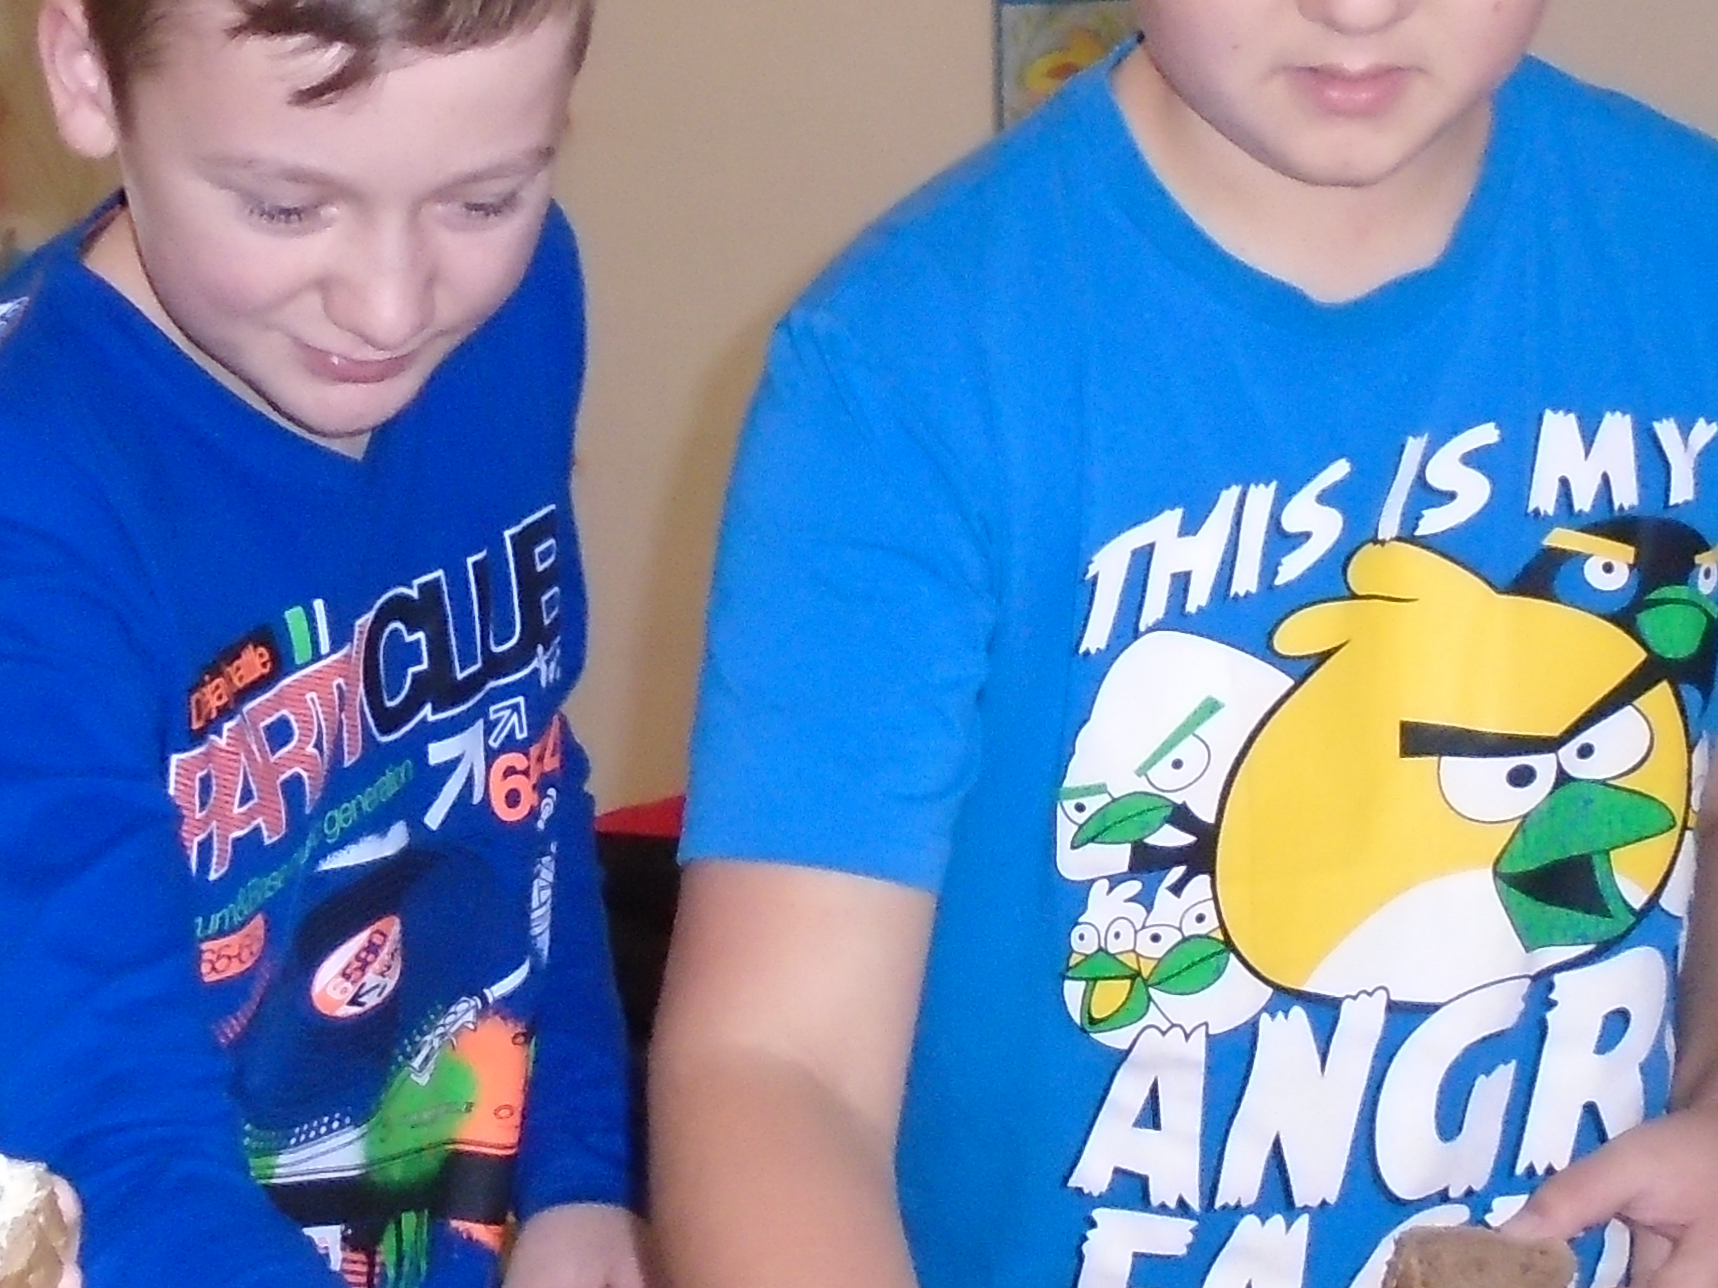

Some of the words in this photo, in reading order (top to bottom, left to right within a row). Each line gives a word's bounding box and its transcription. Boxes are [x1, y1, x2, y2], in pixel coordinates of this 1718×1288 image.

[1079, 457, 1351, 654] THIS
[1377, 421, 1501, 541] IS
[1529, 408, 1718, 517] MY
[1066, 945, 1677, 1210] ANGR
